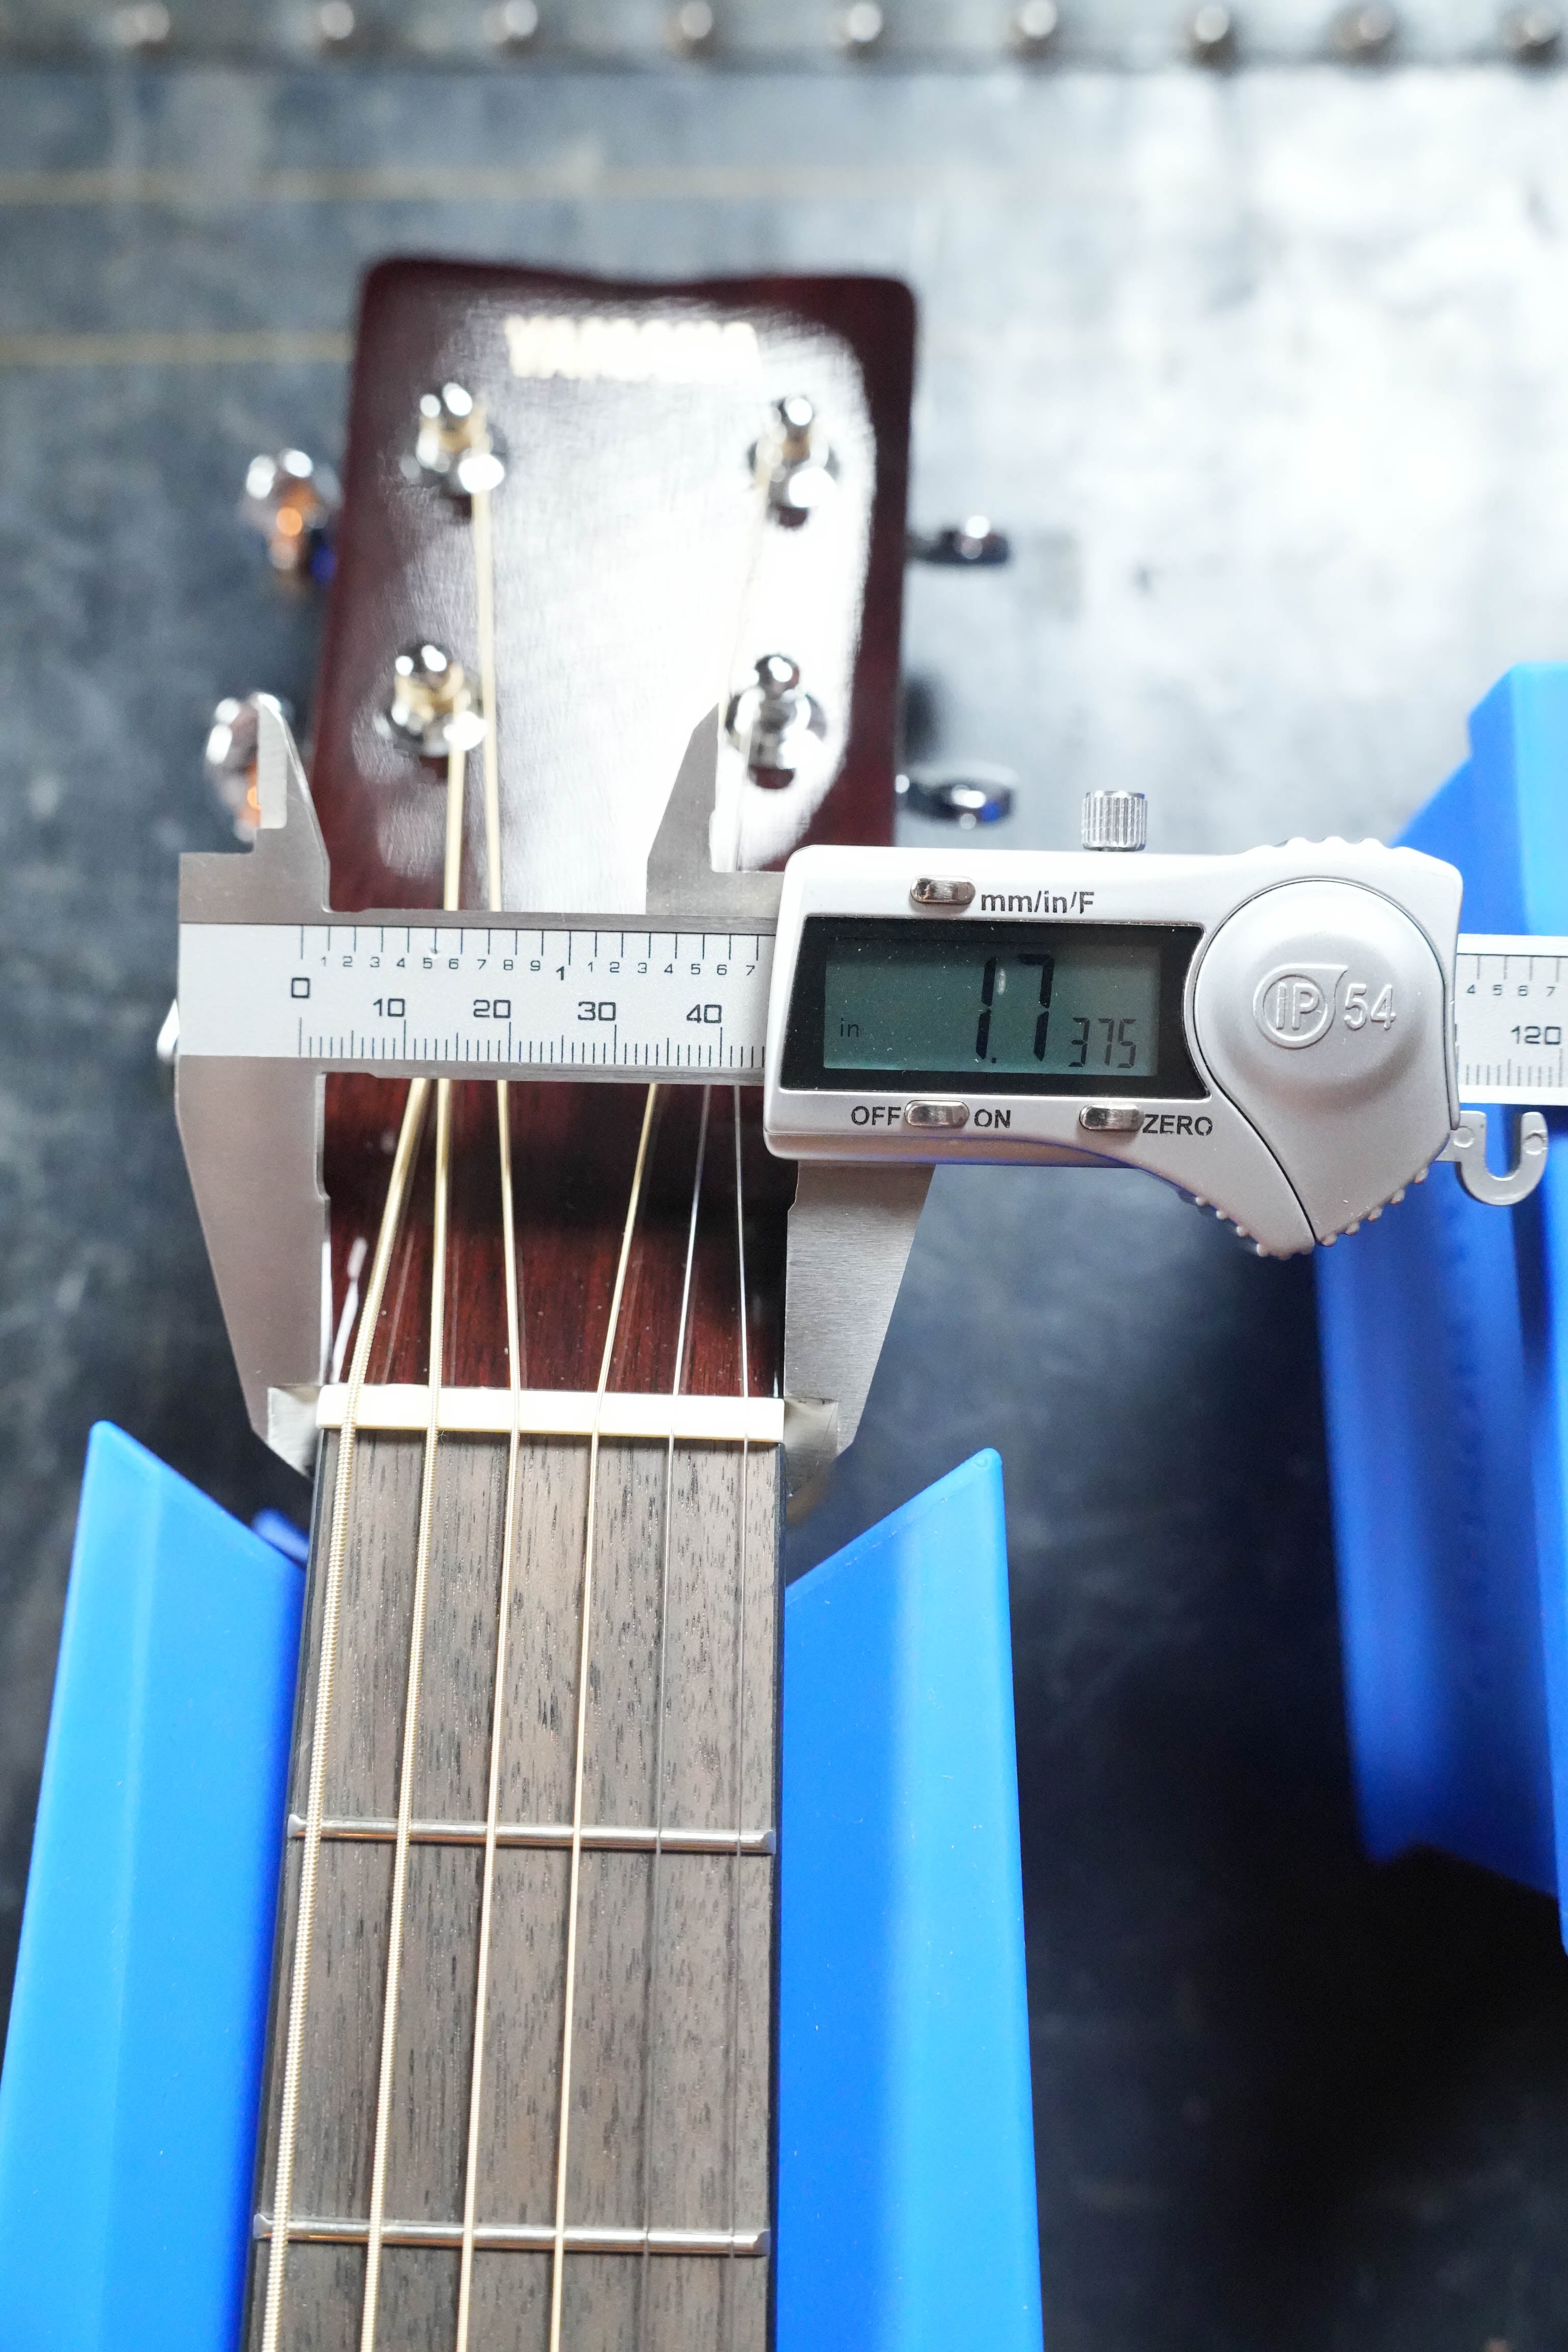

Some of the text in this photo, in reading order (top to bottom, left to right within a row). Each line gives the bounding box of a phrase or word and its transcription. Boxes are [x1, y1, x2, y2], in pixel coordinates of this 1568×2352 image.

[981, 890, 1094, 914] mm/in/F
[321, 955, 541, 971] 1 2 3 4 5 6 7 8 9
[587, 961, 755, 976] 1 2 3 4 5 6 7
[556, 966, 565, 981] 1
[290, 977, 310, 999] 0
[1466, 984, 1556, 997] 4 5 6 7
[373, 998, 722, 1024] 10 20 30 40
[1275, 981, 1396, 1031] IP 54
[840, 1017, 860, 1038] in
[1511, 1025, 1561, 1045] 120
[850, 1106, 901, 1126] OFF
[974, 1109, 1011, 1129] ON
[1141, 1114, 1213, 1136] ZERO
